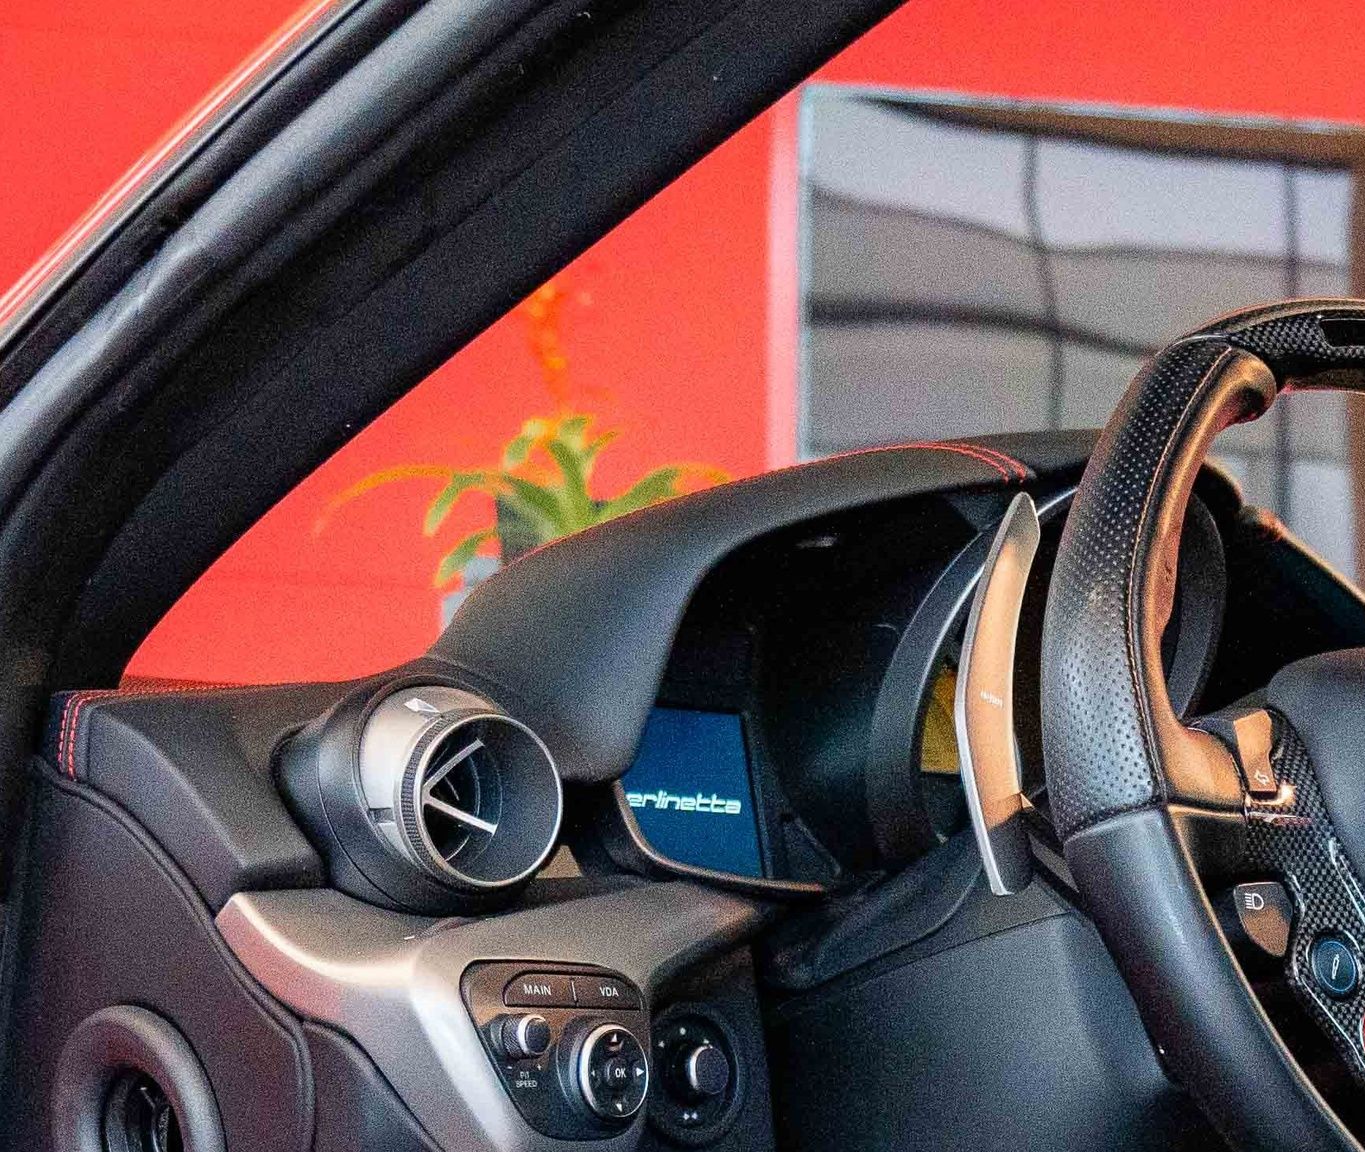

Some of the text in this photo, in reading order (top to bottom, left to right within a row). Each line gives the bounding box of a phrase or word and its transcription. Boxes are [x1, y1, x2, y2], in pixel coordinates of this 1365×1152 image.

[523, 984, 552, 996] MAIN
[599, 986, 620, 997] VDA
[615, 1067, 627, 1078] OK
[515, 1080, 538, 1088] SPEED
